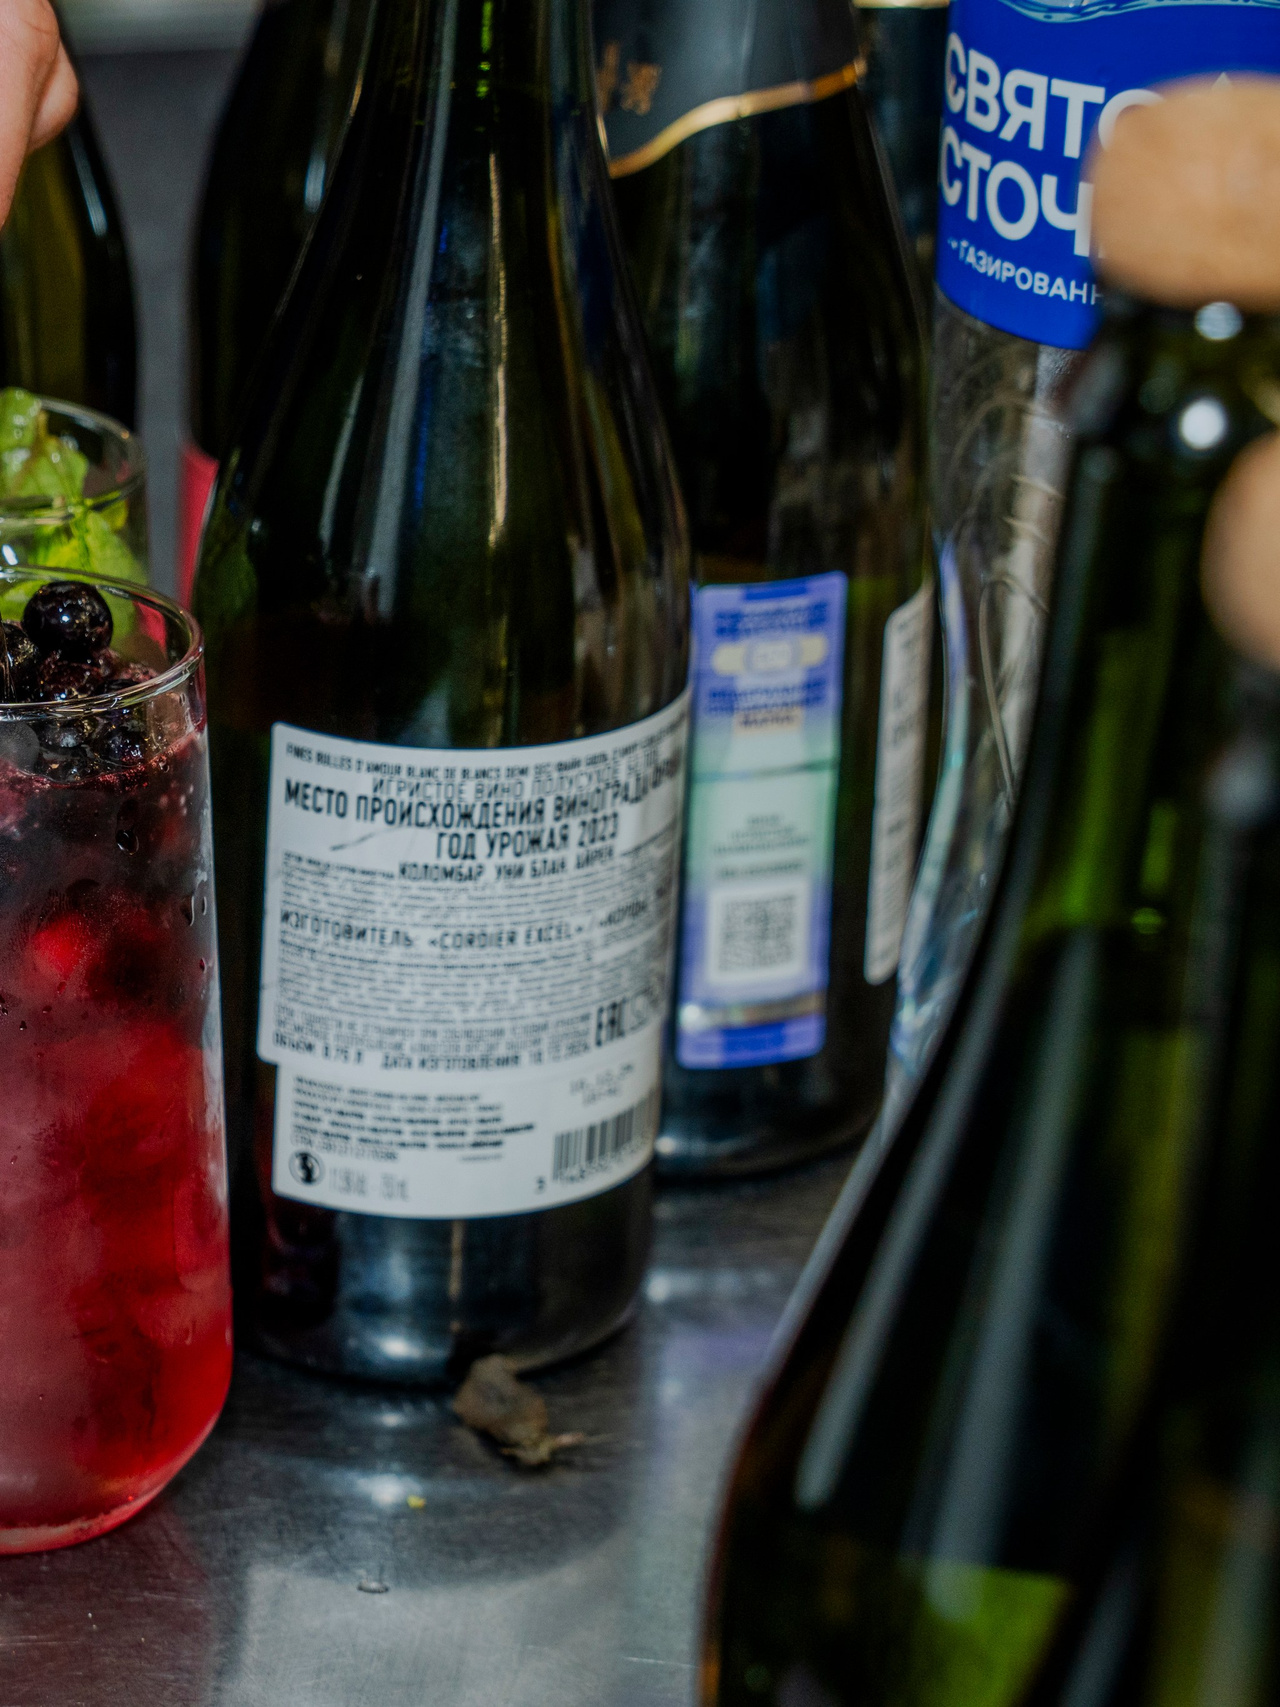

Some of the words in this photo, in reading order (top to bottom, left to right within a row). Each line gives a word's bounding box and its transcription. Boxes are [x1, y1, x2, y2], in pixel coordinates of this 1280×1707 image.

[407, 766, 439, 780] BLANC
[372, 777, 466, 801] ИГРИСТОЕ
[475, 780, 524, 800] ВИНО
[285, 778, 348, 819] МЕСТО
[356, 795, 545, 829] ПРОИСХОЖДЕНИЯ
[437, 831, 476, 861] ГОД
[486, 823, 569, 859] УРОЖАЯ
[578, 811, 618, 848] 2023
[399, 861, 484, 883] КОЛОМБАР
[495, 863, 524, 881] УНИ
